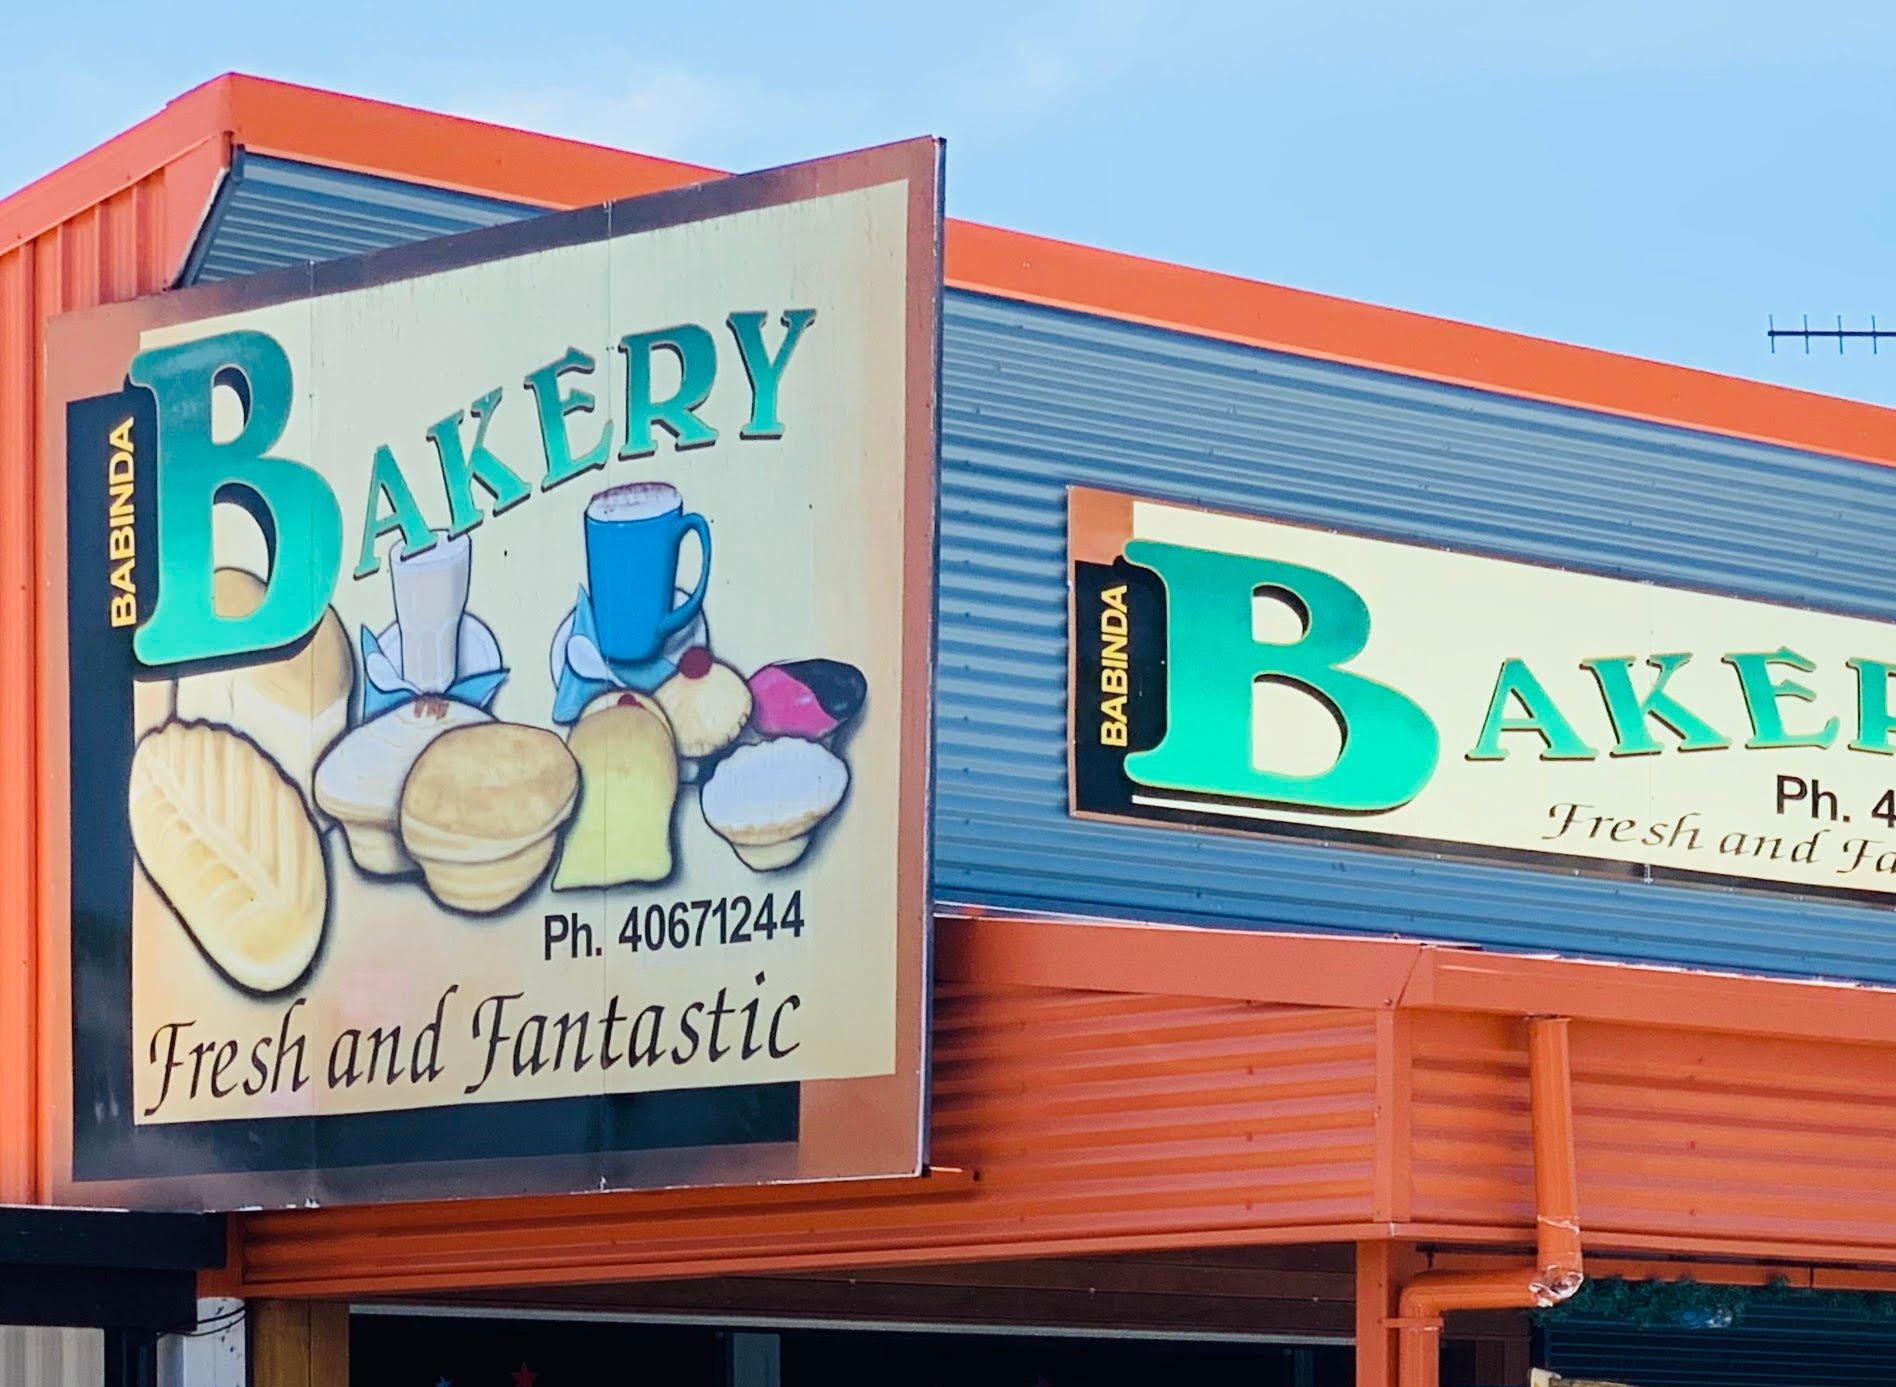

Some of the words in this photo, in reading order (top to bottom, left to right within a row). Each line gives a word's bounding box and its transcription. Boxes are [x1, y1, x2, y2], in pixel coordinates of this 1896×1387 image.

[108, 415, 136, 628] BABINDA
[127, 309, 819, 668] BAKERY
[1099, 583, 1130, 748] BABINDA
[1545, 800, 1704, 852] Fresh
[1719, 826, 1820, 866] and
[1776, 773, 1851, 824] Ph.
[544, 914, 604, 962] Ph.
[618, 891, 807, 956] 40671244
[144, 999, 312, 1119] Fresh
[328, 984, 457, 1086] and
[465, 971, 804, 1098] Fantastic
